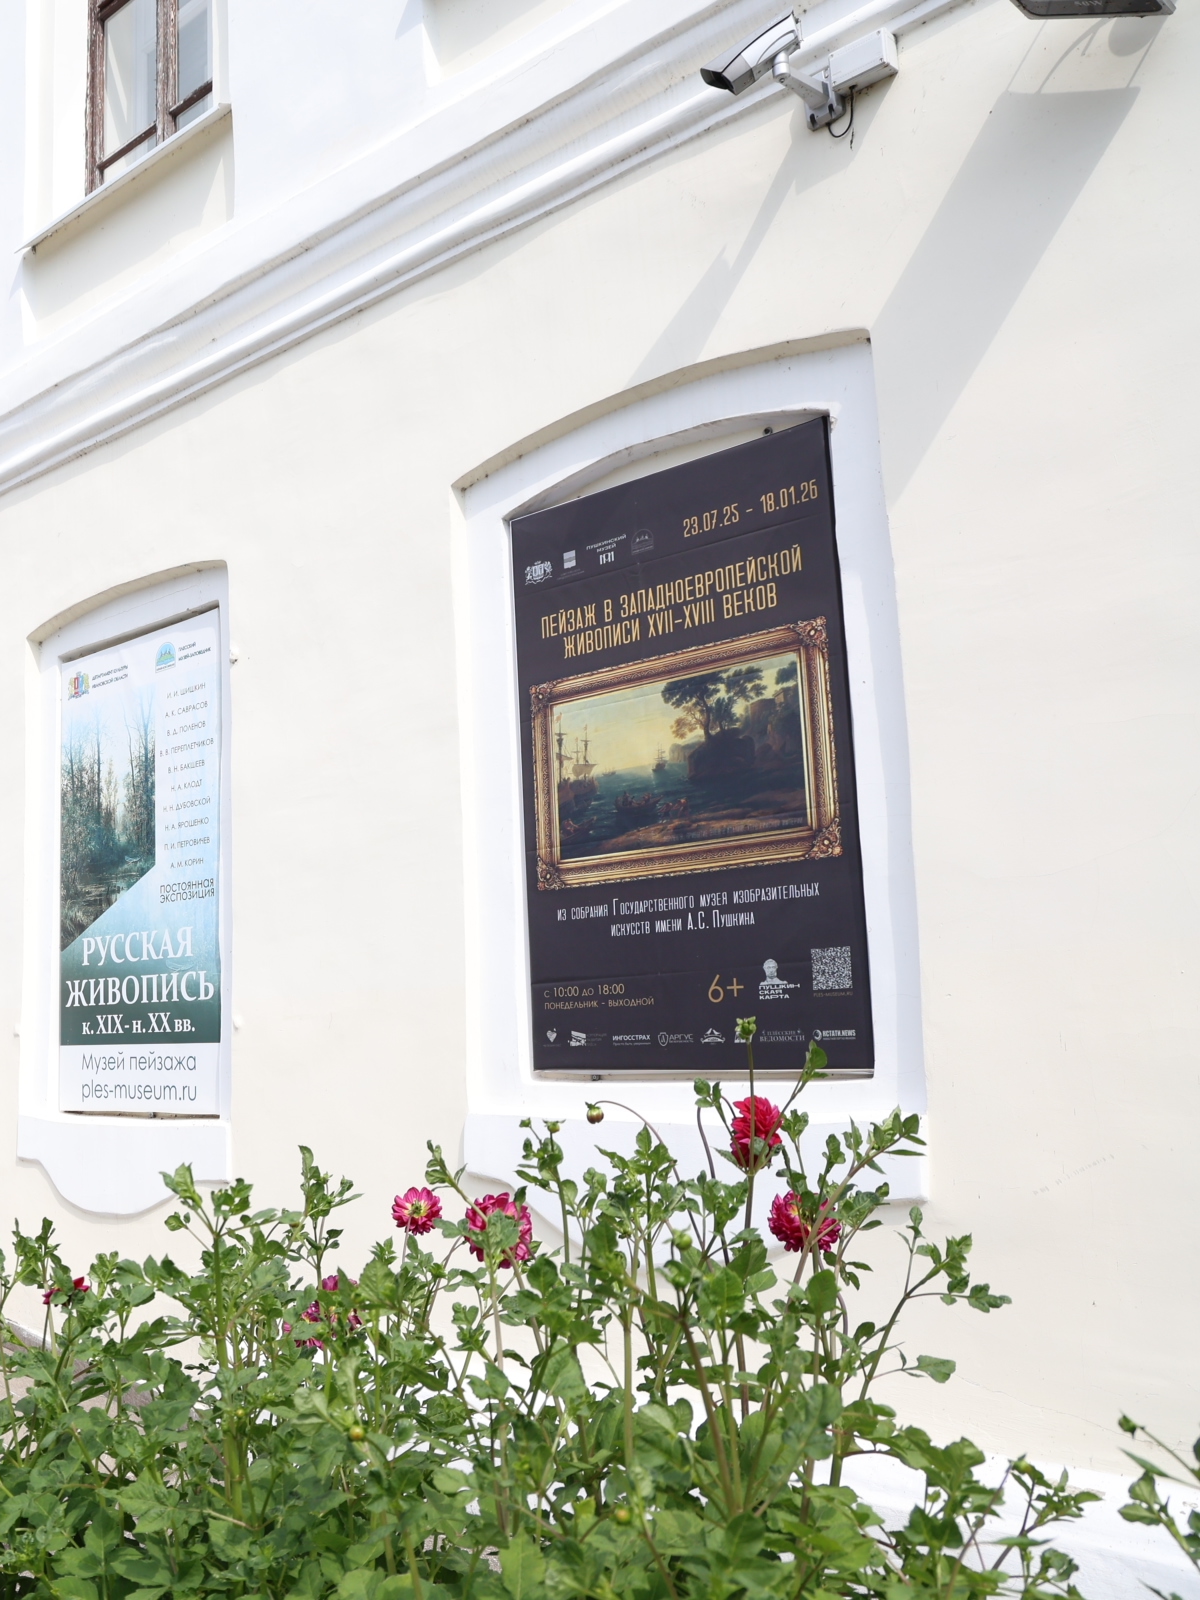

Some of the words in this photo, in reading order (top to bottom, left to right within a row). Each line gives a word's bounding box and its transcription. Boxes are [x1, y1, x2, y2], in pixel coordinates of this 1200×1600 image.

[683, 503, 739, 538] 23.07.25
[759, 479, 818, 515] 18.01.26
[586, 533, 627, 550] ПУШКИНСКИЙ
[596, 543, 617, 553] МУЗЕЙ
[541, 599, 597, 639] ПЕЙЗАЖ
[604, 599, 613, 622] В
[619, 544, 803, 618] ЗАПАДНОЕВРОПЕЙСКОЙ
[564, 615, 641, 659] ЖИВОПИСИ
[648, 598, 715, 638] XVII-XVIII
[723, 582, 778, 619] ВЕКОВ
[180, 682, 206, 696] ШИШКИН
[165, 711, 170, 719] А.
[177, 700, 208, 715] САВРАСОВ
[172, 728, 178, 736] Д.
[179, 720, 206, 733] ПОЛЕНОВ
[170, 737, 214, 755] ПЕРЕПЛЕТЧИКОВ
[167, 766, 172, 774] В.
[180, 759, 205, 771] БАКШЕЕВ
[184, 779, 203, 790] КЛОДТ
[163, 805, 168, 813] Н.
[169, 804, 174, 812] Н.
[175, 796, 211, 811] ДУБОВСКОЙ
[177, 817, 209, 829] ЯРОШЕНКО
[177, 836, 210, 848] ПЕТРОВИЧЕВ
[184, 857, 204, 867] КОРИН
[159, 888, 215, 904] ЭКСПОЗИЦИЯ
[557, 908, 567, 921] ИЗ
[571, 902, 609, 919] СОБРАНИЯ
[700, 891, 728, 908] МУЗЕЯ
[733, 882, 820, 906] ИЗОБРАЗИТЕЛЬНЫХ
[610, 919, 651, 937] ИСКУССТВ
[655, 916, 682, 933] ИМЕНИ
[687, 911, 709, 931] А.С.
[81, 926, 194, 966] РУССКАЯ
[65, 970, 215, 1008] ЖИВОПИСЬ
[543, 990, 550, 998] С
[554, 986, 579, 998] 10:00
[581, 987, 594, 997] ДО
[598, 983, 625, 995] 18:00
[708, 974, 744, 1003] 6+
[544, 1000, 599, 1010] ПОНЕДЕЛЬНИК
[608, 996, 655, 1008] ВЫХОДНОЙ
[148, 1012, 171, 1033] XX
[174, 1018, 196, 1032] вв.
[759, 1034, 805, 1042] ВЕДОМОСТИ
[81, 1051, 125, 1075] Музей
[129, 1050, 197, 1072] пейзажа
[81, 1079, 197, 1102] ples-museum.ru
